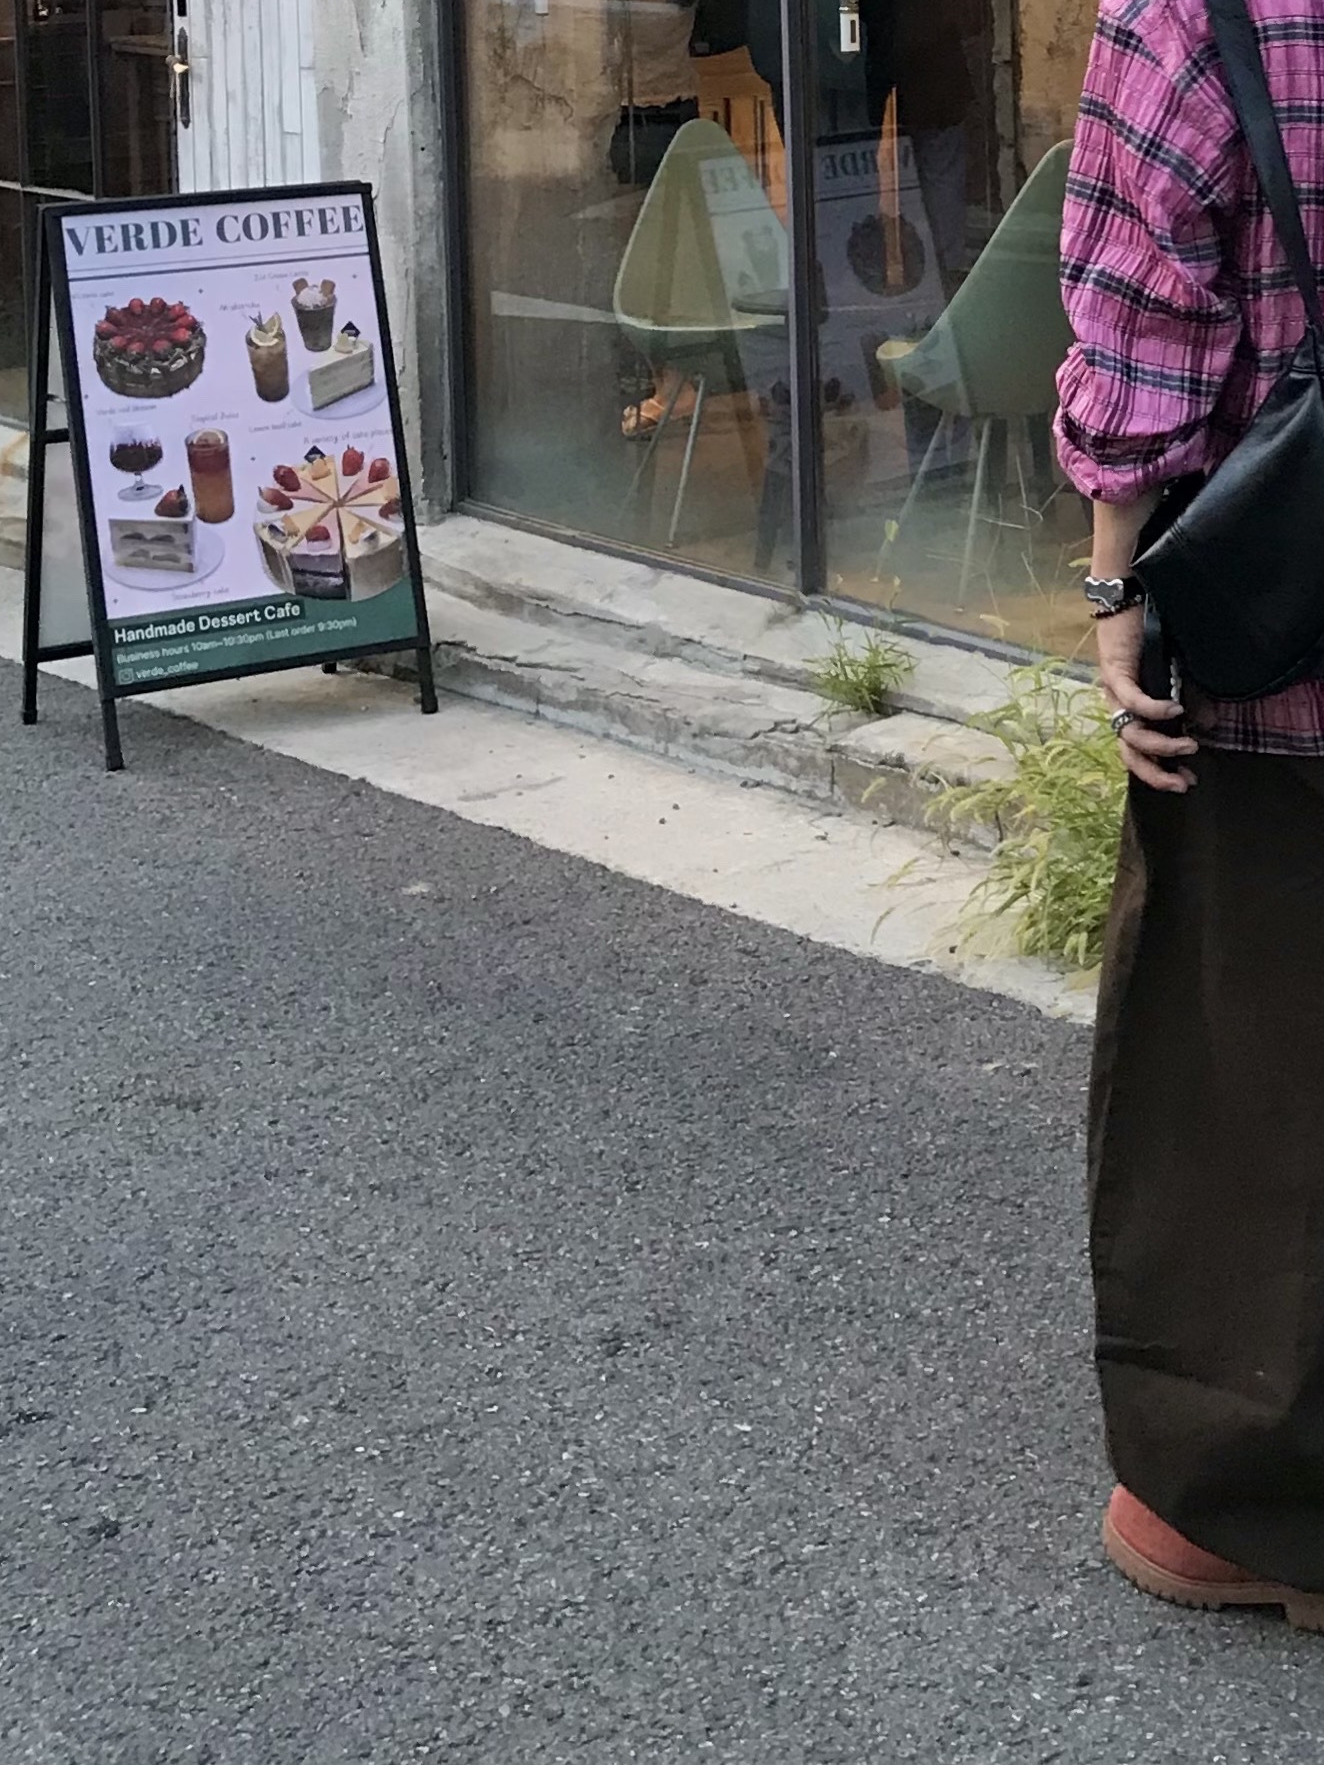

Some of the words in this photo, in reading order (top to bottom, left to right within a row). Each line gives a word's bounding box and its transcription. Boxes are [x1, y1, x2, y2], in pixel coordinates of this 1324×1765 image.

[65, 217, 203, 257] VERDE
[215, 204, 364, 244] COFFEE
[114, 619, 195, 644] Handmade
[198, 609, 262, 631] Dessert
[264, 601, 301, 620] Cafe
[116, 650, 160, 665] Business
[161, 645, 190, 657] hours
[266, 628, 290, 642] (Last
[291, 624, 316, 637] order
[317, 616, 358, 633] 9:30pm)
[136, 660, 199, 679] verde_coffee
